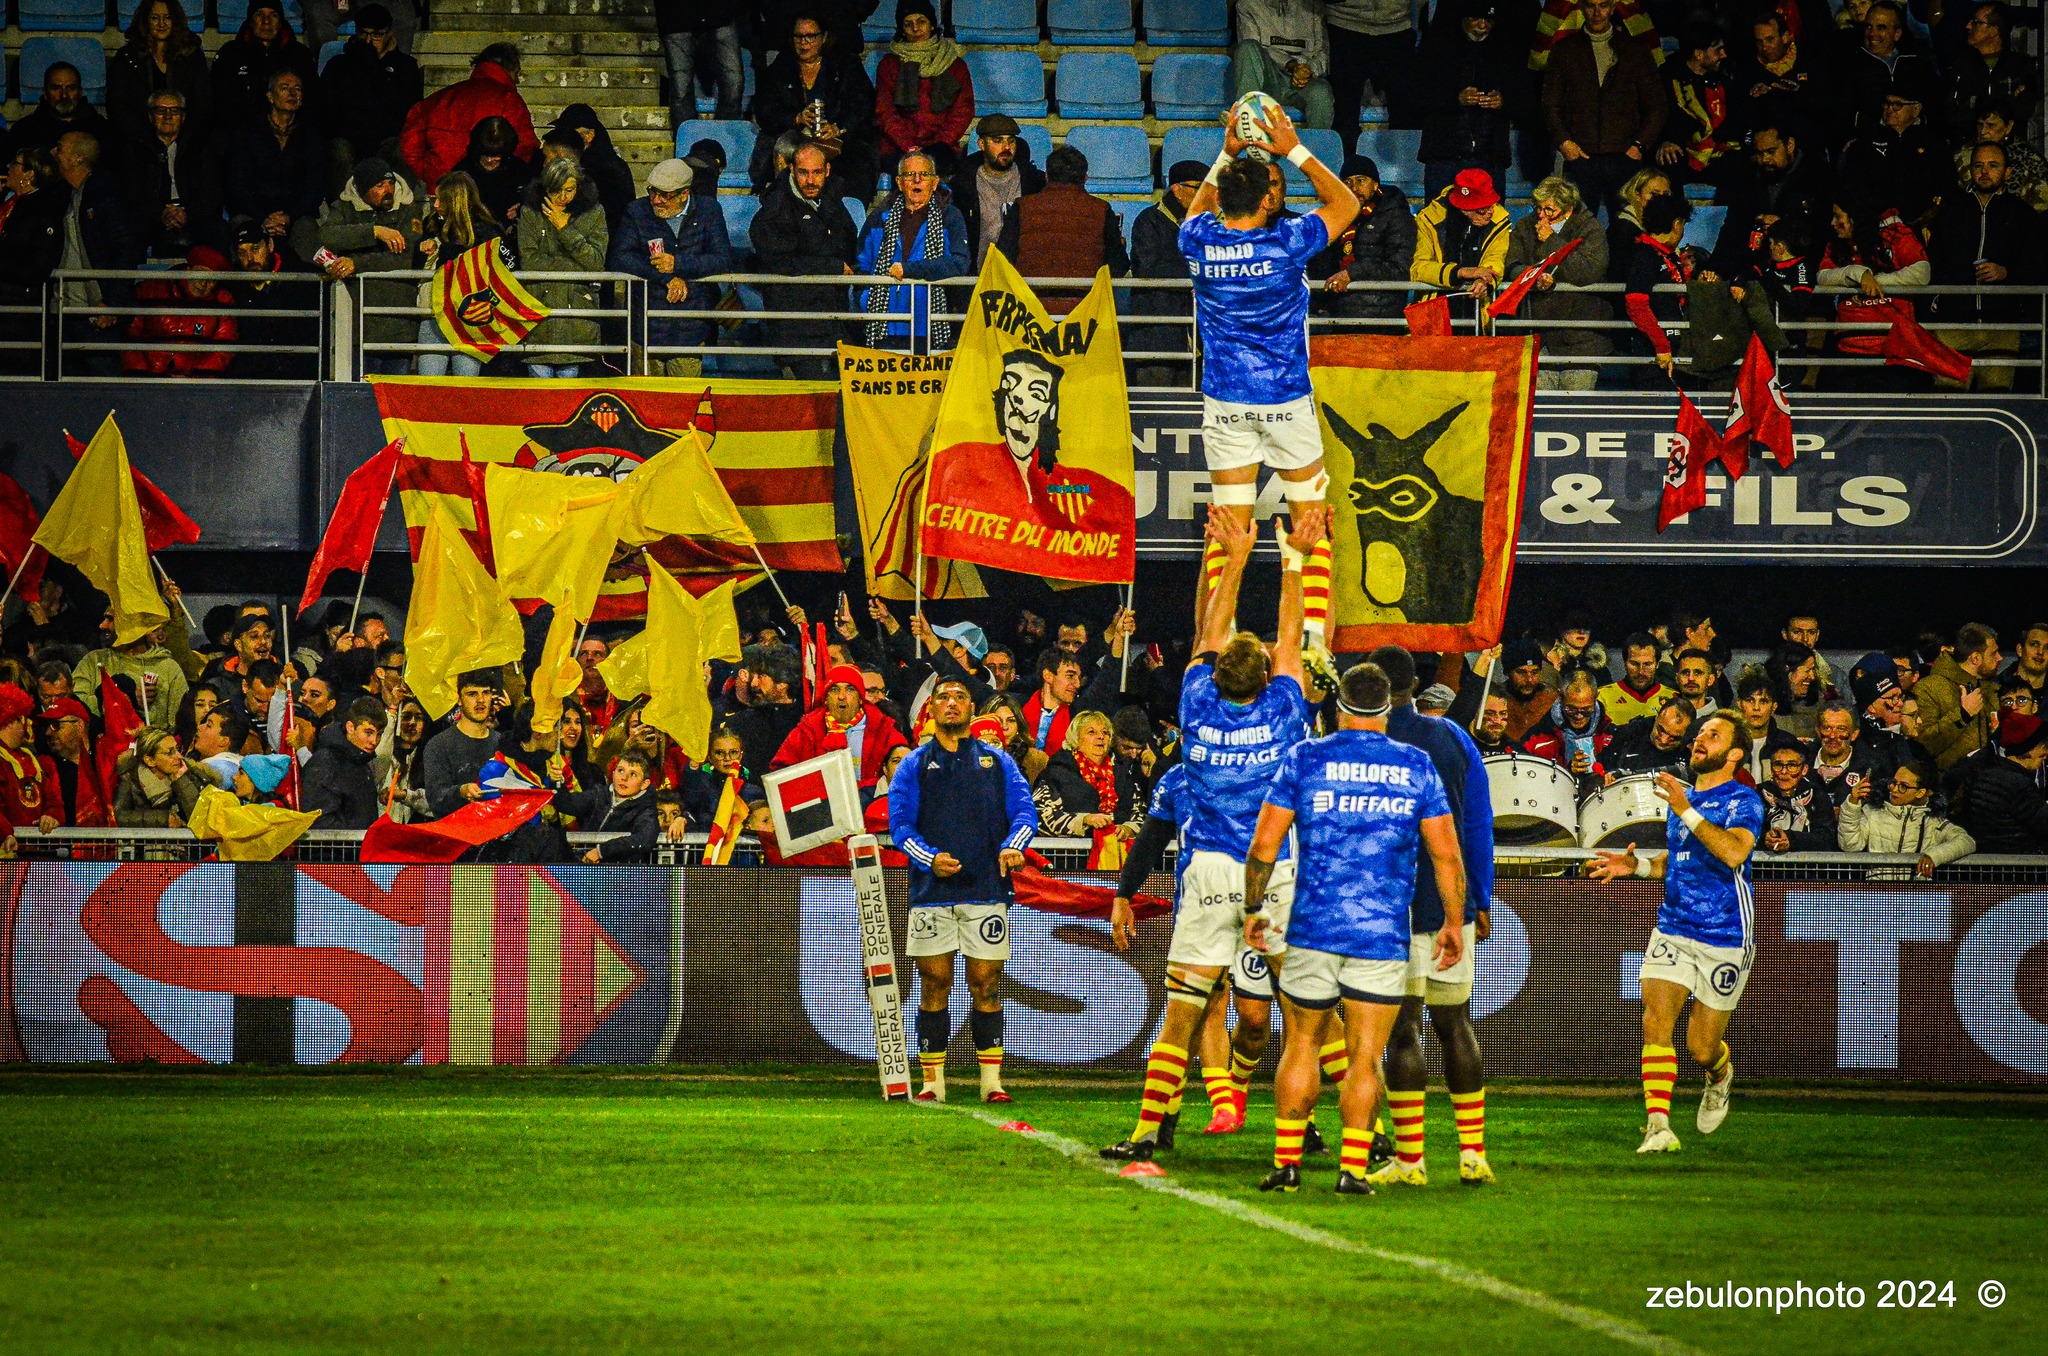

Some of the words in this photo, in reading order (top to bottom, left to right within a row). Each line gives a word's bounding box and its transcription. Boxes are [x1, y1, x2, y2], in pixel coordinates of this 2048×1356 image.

[1204, 243, 1254, 261] BRAZO
[1204, 260, 1273, 278] EIFFAGE
[844, 356, 874, 373] PAS
[878, 358, 896, 373] DE
[851, 379, 891, 395] SANS
[897, 379, 916, 395] DE
[920, 379, 946, 394] GR
[1534, 432, 1627, 458] DE
[1540, 473, 1621, 525] &
[925, 503, 1011, 540] CENTRE
[1010, 520, 1047, 548] DU
[1046, 529, 1121, 559] MONDE
[1210, 746, 1280, 767] EIFFAGE
[1326, 761, 1411, 786] ROELOFSE
[1338, 795, 1417, 816] EIFFAGE
[860, 891, 879, 957] SOCIETE
[869, 874, 890, 956] GENERALE
[876, 1009, 895, 1076] SOCIETE
[885, 993, 906, 1075] GENERALE
